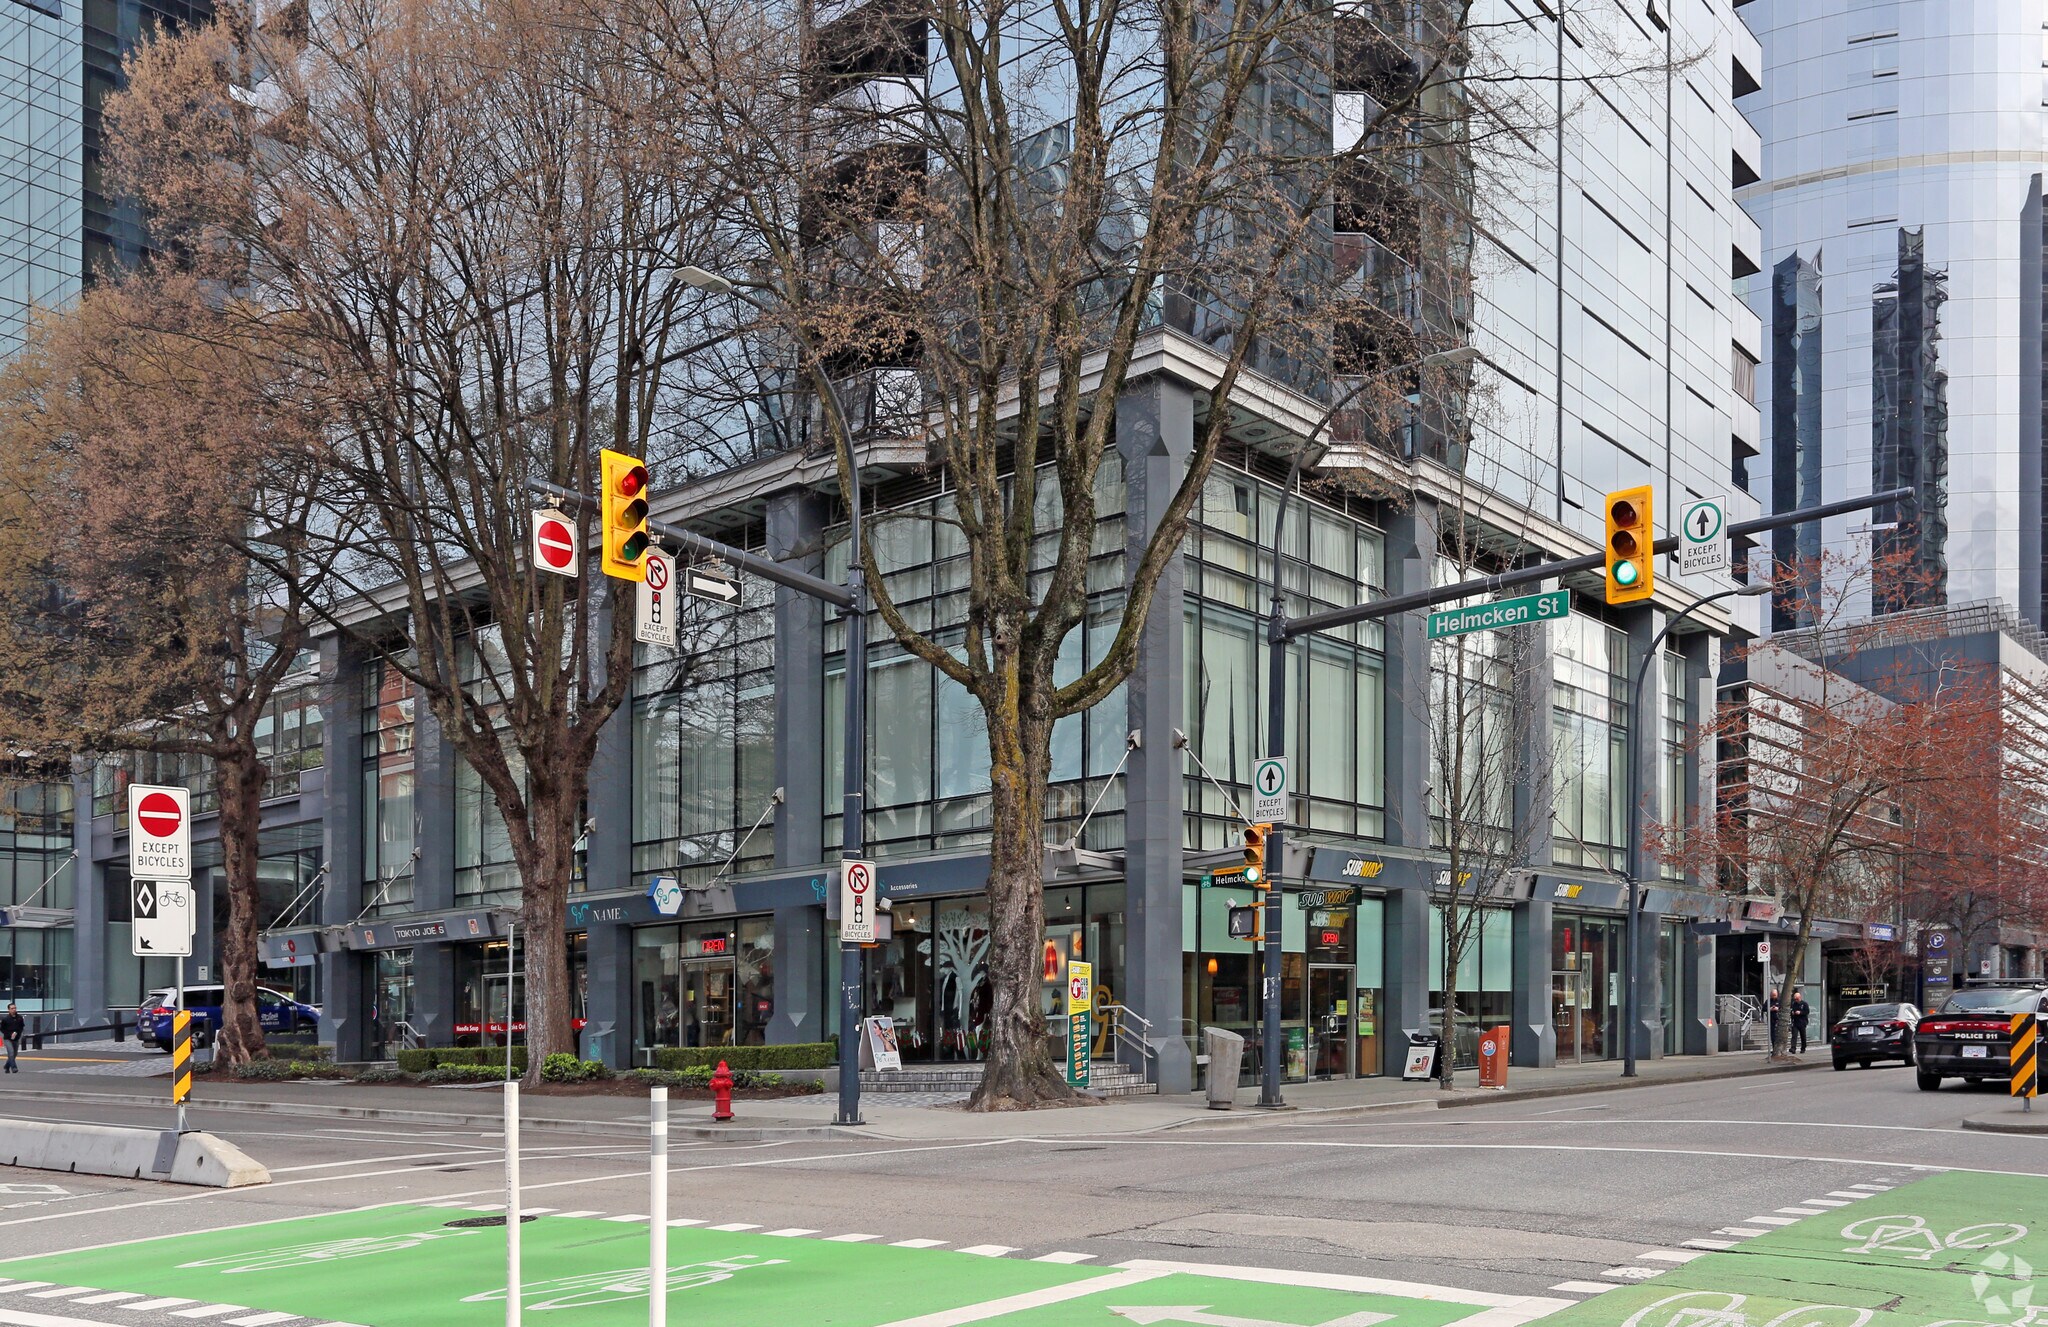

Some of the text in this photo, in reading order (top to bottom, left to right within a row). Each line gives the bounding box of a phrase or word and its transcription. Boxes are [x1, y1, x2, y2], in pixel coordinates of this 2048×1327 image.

[1688, 543, 1717, 557] EXCEPT
[1684, 554, 1721, 569] BICYCLES
[1436, 597, 1559, 634] Helmcken St
[644, 622, 668, 633] EXCEPT
[641, 630, 671, 642] BICYCLES
[1259, 798, 1281, 808] EXCEPT
[1256, 807, 1284, 818] BICYCLES
[142, 842, 180, 854] EXCEPT
[138, 856, 184, 868] BICYCLES
[1342, 859, 1384, 878] SUBWAY
[1215, 874, 1246, 885] Helmcke
[890, 883, 918, 891] Accessories
[1554, 883, 1583, 898] SUBWAY
[1299, 889, 1353, 907] SUBWAY
[848, 923, 869, 931] EXCEPT
[396, 928, 420, 938] TOKYO
[844, 930, 871, 939] BICYCLES
[1322, 933, 1338, 943] OPEN
[702, 939, 725, 952] OPEN
[1483, 1041, 1495, 1050] 24
